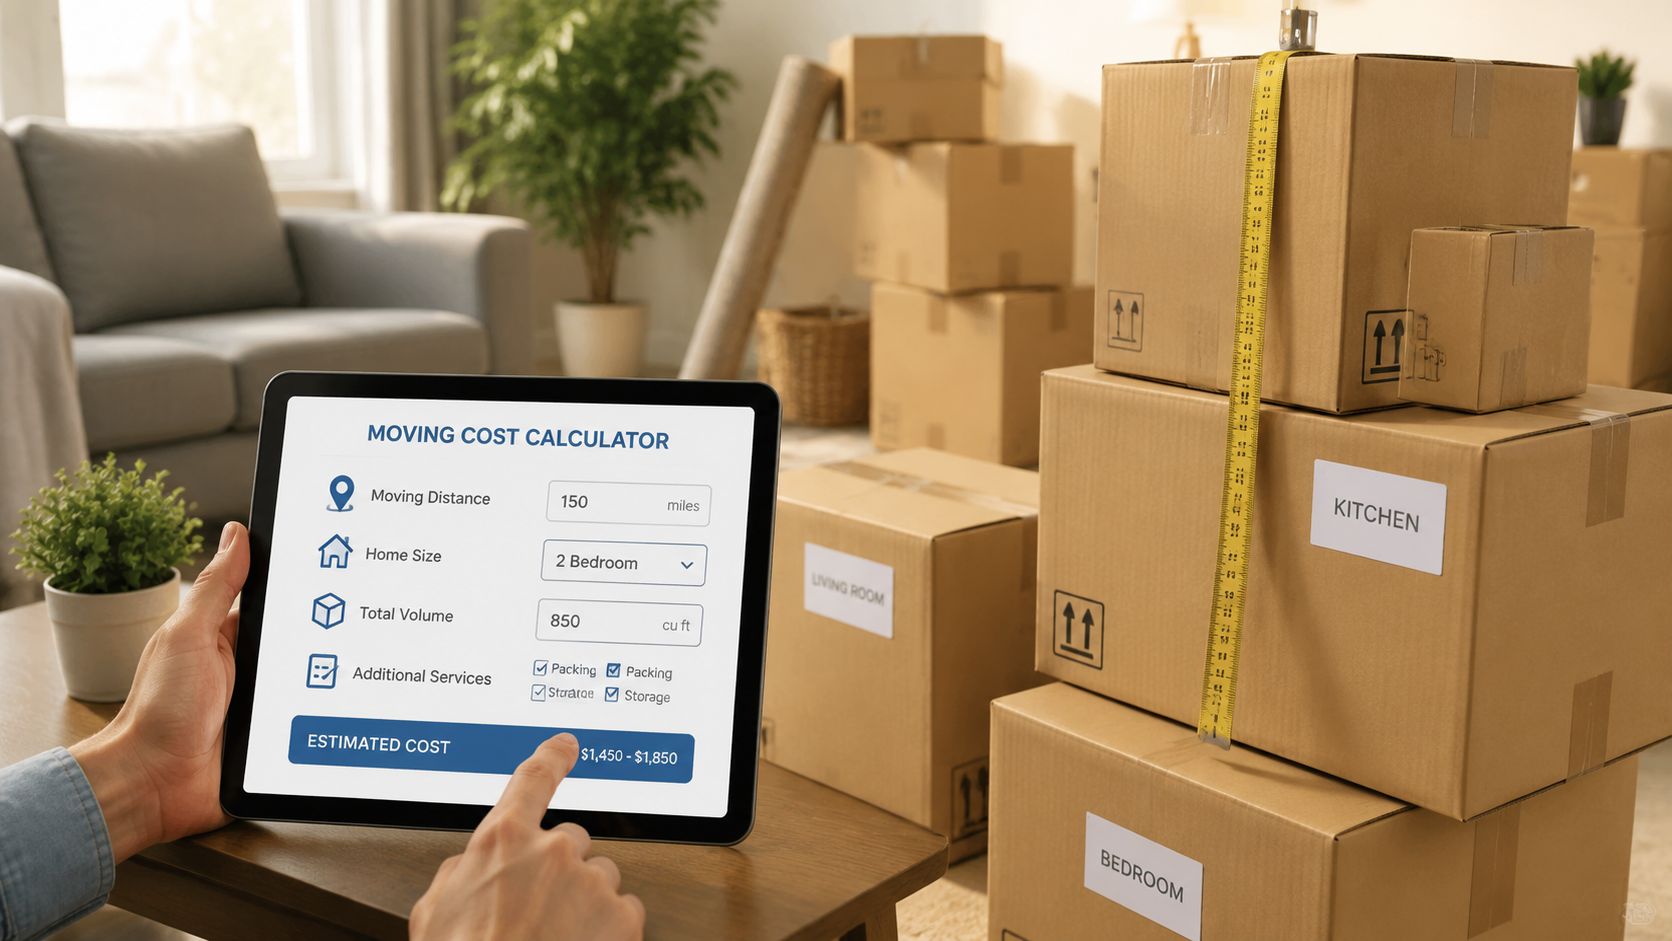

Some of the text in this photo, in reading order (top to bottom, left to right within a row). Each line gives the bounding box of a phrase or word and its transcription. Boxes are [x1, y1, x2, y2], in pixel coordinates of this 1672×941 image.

[367, 424, 670, 450] MOVING COST CALCULATOR
[371, 488, 491, 507] Moving Distance
[561, 494, 700, 512] 150 miles
[1334, 497, 1420, 533] KITCHEN
[365, 547, 442, 563] Home Size
[555, 553, 638, 570] 2 Bedroom
[811, 573, 885, 607] LIVING ROOM
[359, 606, 454, 623] Total Volume
[550, 613, 691, 632] 850 cu ft
[352, 666, 492, 686] Additional Services
[551, 662, 597, 679] Packing
[626, 665, 673, 682] Packing
[624, 689, 671, 706] Storage
[307, 733, 452, 755] ESTIMATED COST
[580, 746, 623, 764] $1,450
[634, 749, 678, 766] $1,850
[1101, 848, 1184, 904] BEDROOM
